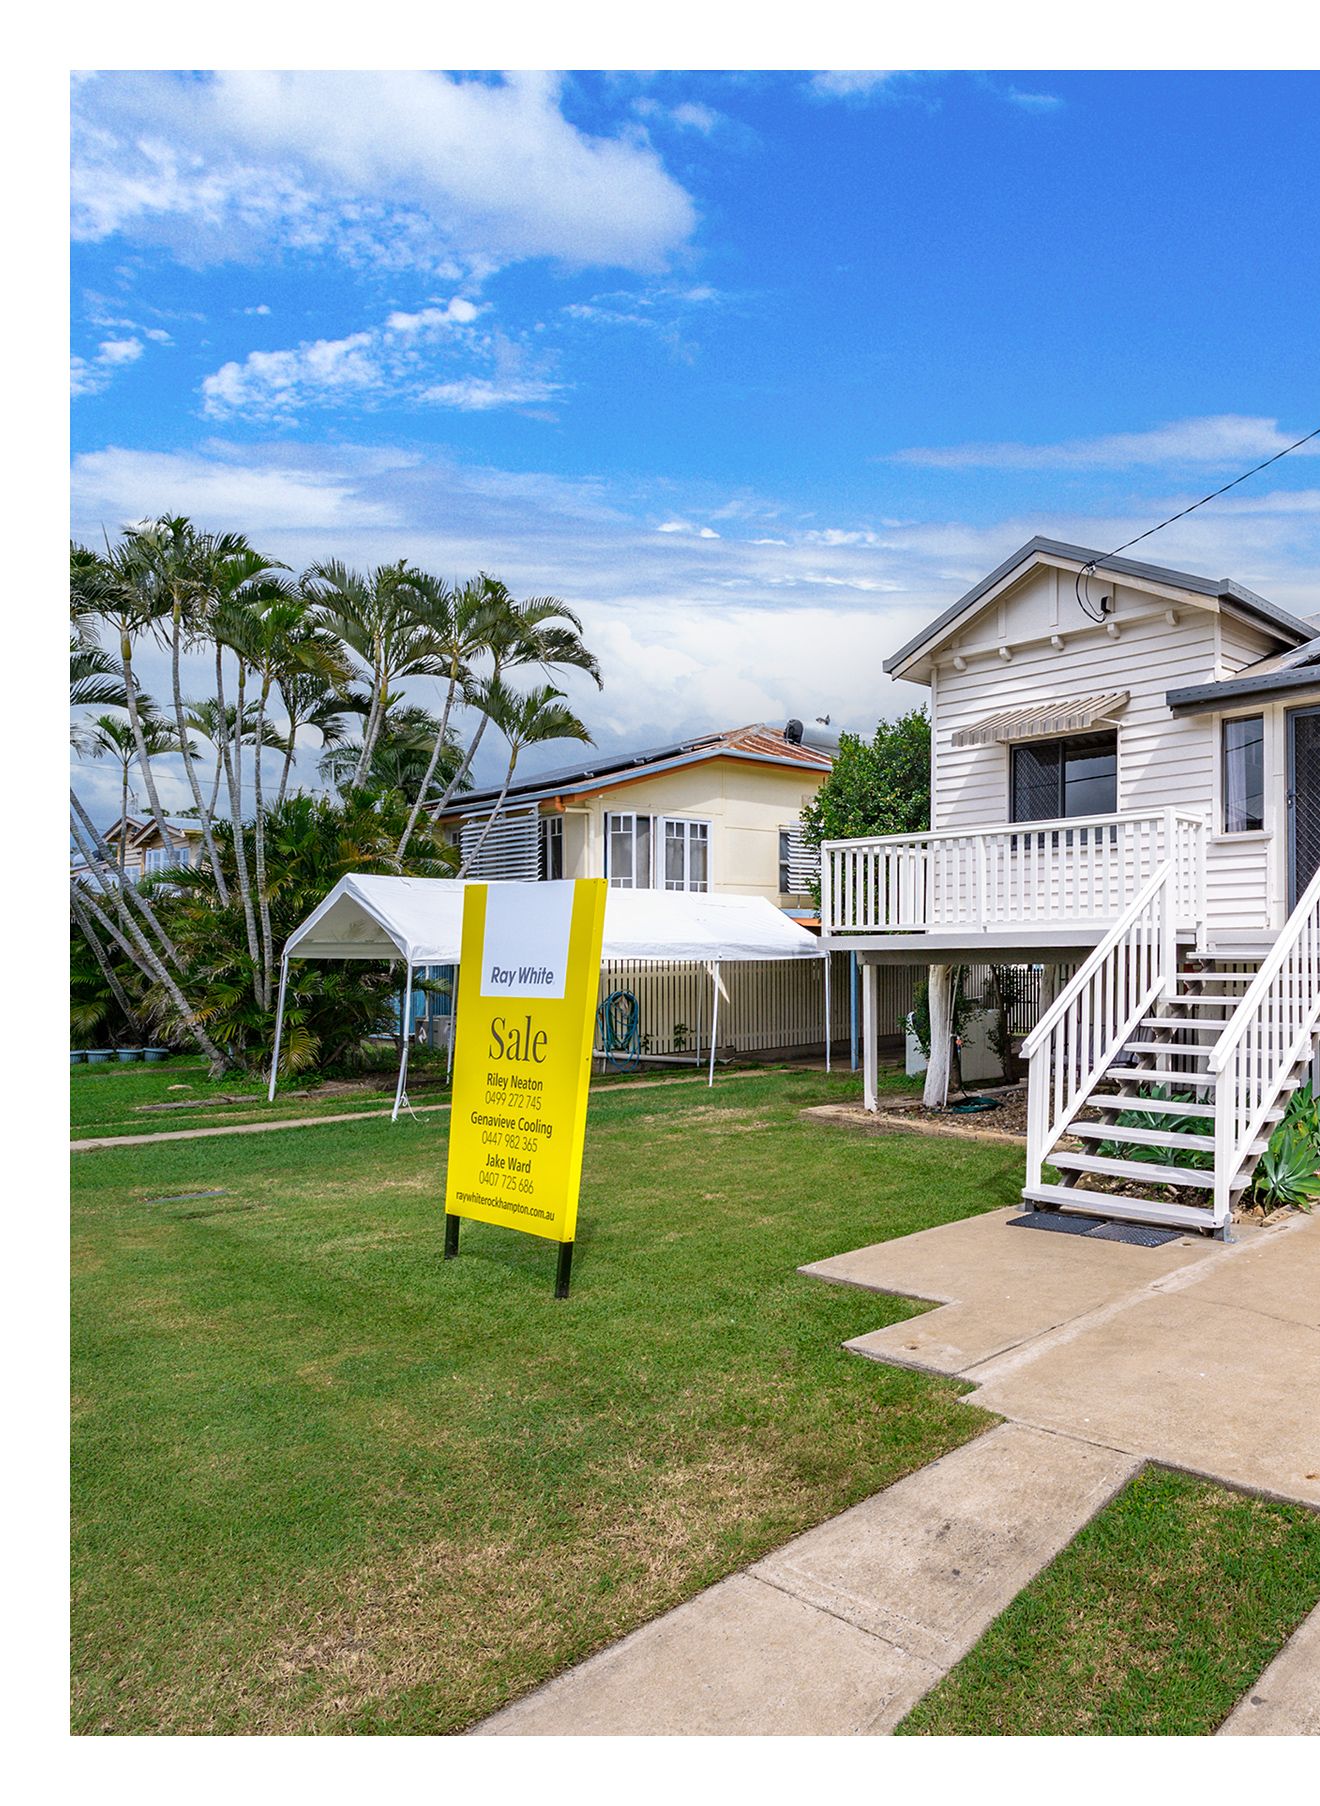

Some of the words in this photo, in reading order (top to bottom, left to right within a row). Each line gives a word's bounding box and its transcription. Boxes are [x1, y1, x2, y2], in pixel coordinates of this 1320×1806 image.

[491, 966, 516, 987] Ray
[519, 967, 554, 984] White
[488, 1015, 548, 1063] Sale
[487, 1073, 508, 1091] Riley
[510, 1075, 543, 1091] Neaton
[485, 1091, 507, 1105] 0499
[508, 1093, 524, 1108] 272
[526, 1095, 542, 1110] 745
[471, 1111, 516, 1129] Genavieve
[518, 1117, 552, 1139] Cooling
[482, 1130, 502, 1145] 0447
[504, 1134, 519, 1149] 982
[522, 1137, 538, 1152] 365
[486, 1154, 505, 1169] Jake
[508, 1157, 531, 1173] Ward
[479, 1170, 499, 1186] 0407
[502, 1174, 516, 1191] 725
[518, 1178, 534, 1194] 686
[456, 1191, 555, 1221] raywhiterockhampton.com.au
